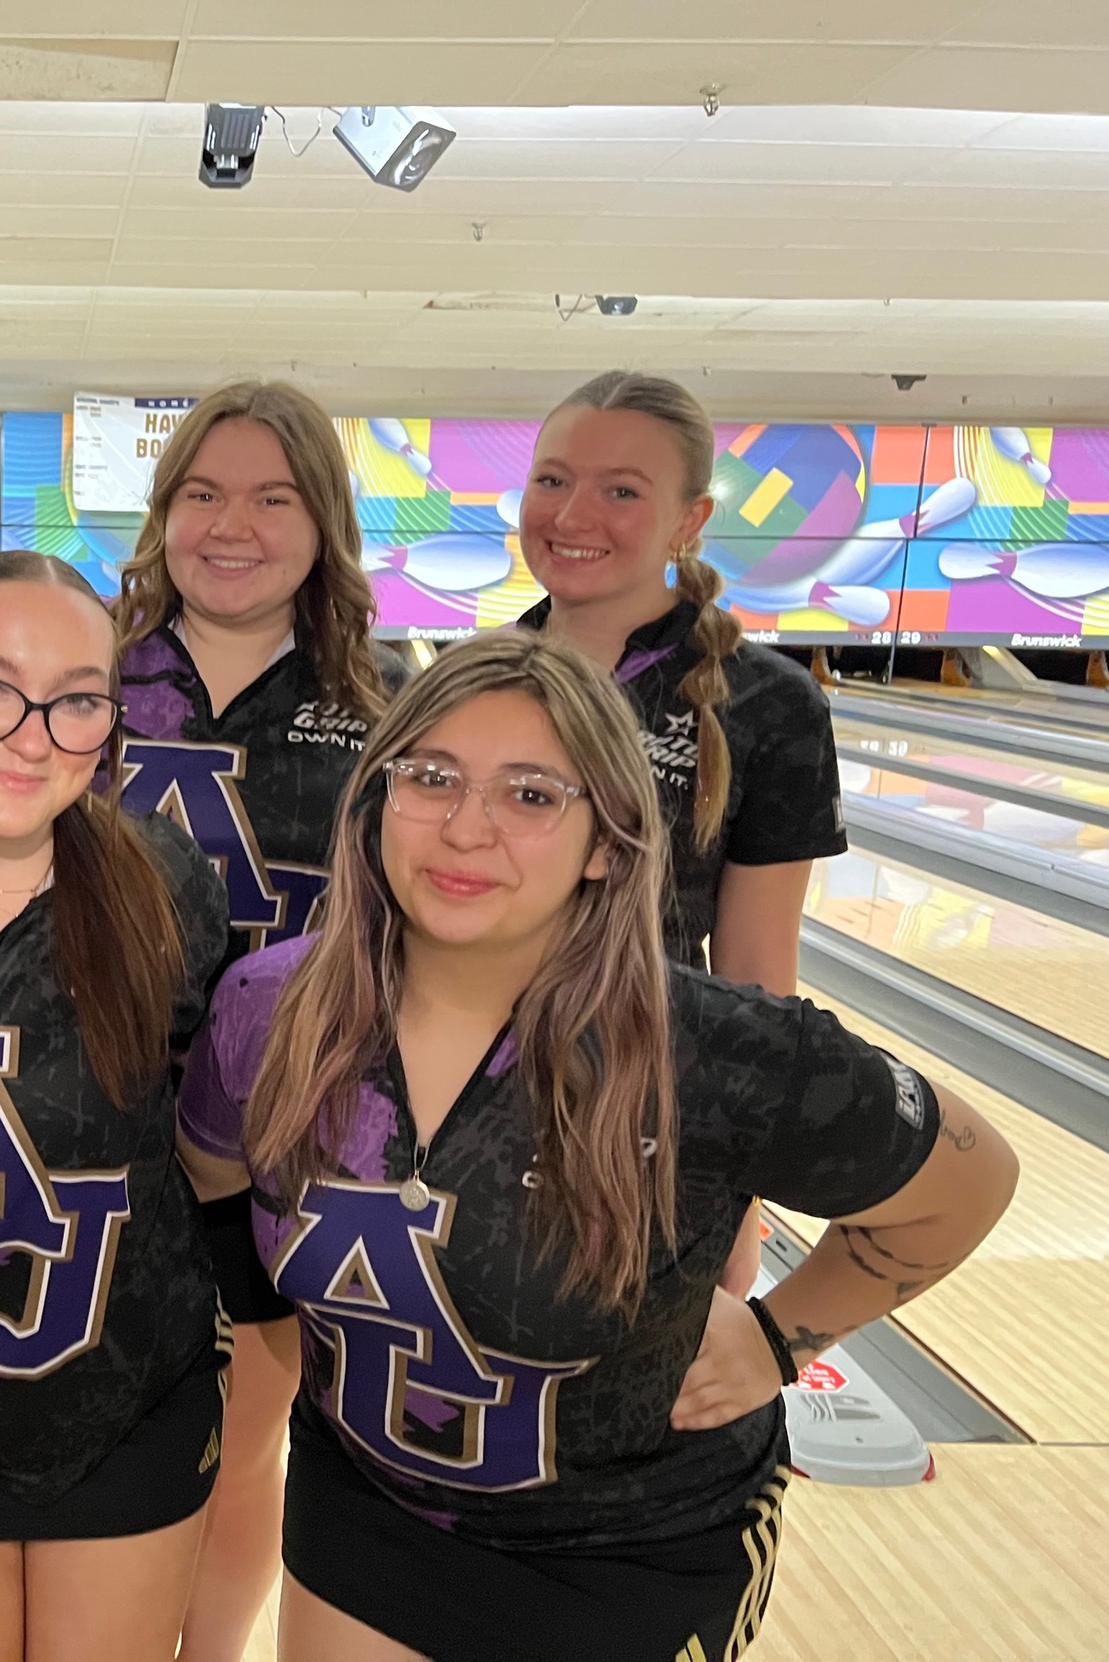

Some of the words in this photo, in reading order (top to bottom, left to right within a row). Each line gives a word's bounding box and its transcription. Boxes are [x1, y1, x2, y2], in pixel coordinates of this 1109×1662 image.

[407, 626, 477, 640] Brunswick
[1011, 633, 1083, 648] Brunswick
[287, 731, 346, 748] OWN
[269, 1177, 600, 1493] AU
